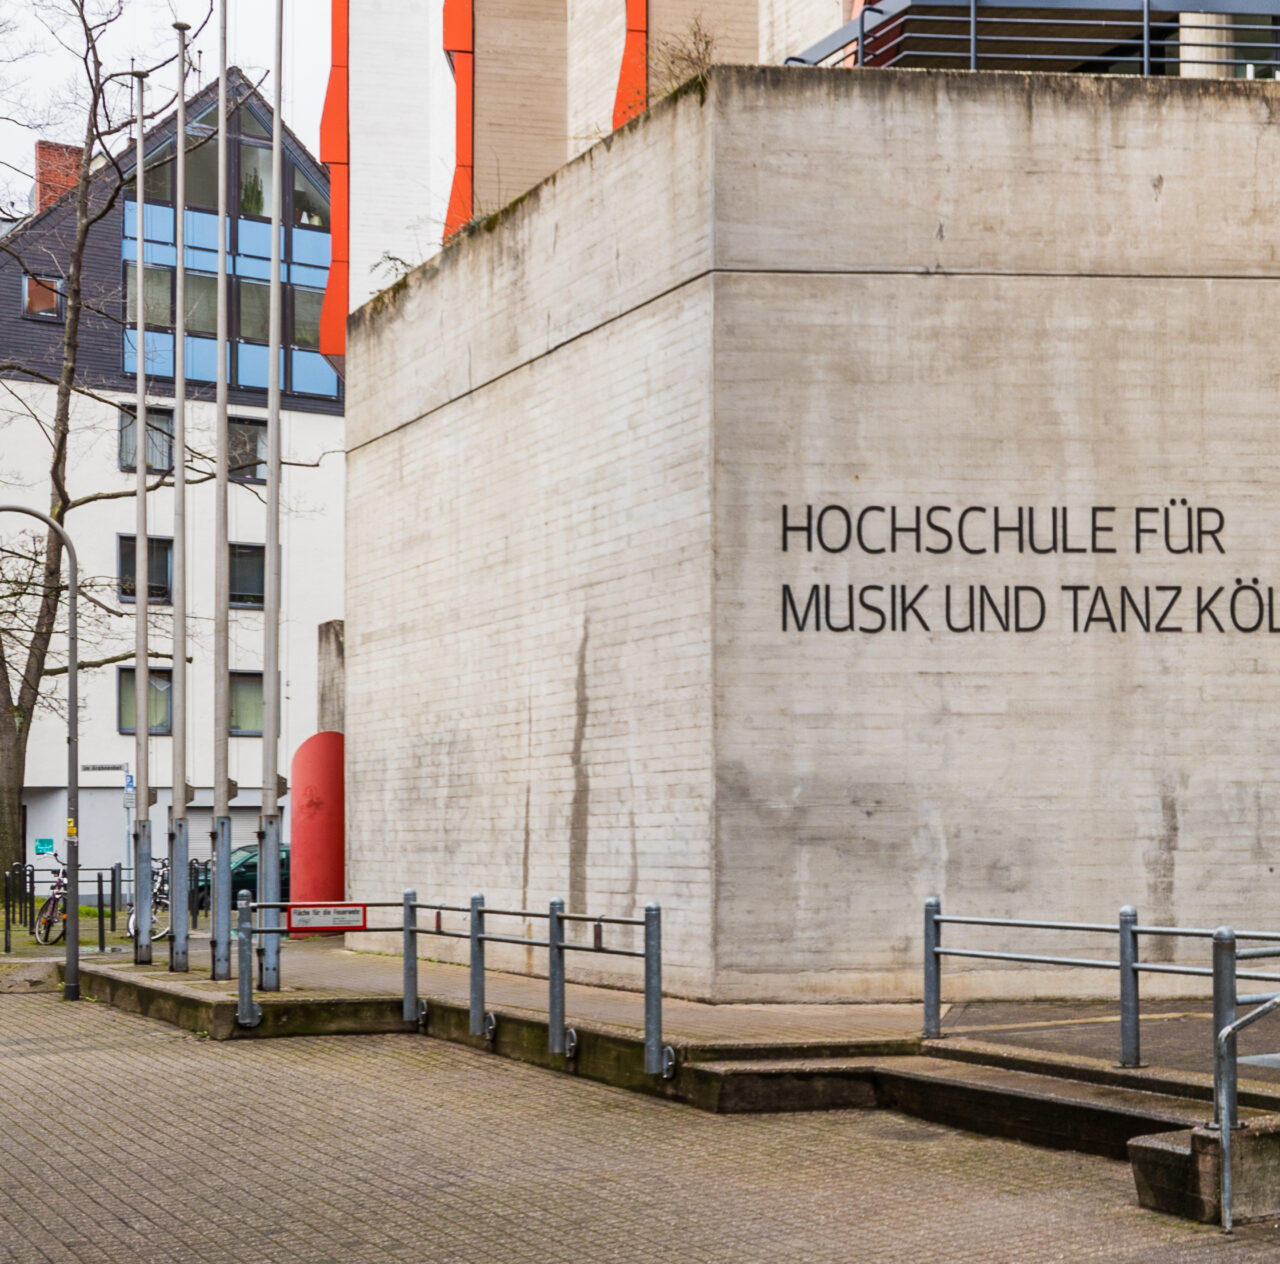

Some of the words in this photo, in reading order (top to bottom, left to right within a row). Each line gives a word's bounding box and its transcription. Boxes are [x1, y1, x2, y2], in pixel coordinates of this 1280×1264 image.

[781, 504, 1117, 554] HOCHSCHULE
[1135, 497, 1226, 554] FÜR
[781, 584, 930, 634] MUSIK
[945, 585, 1047, 634] UND
[1061, 585, 1183, 634] TANZ
